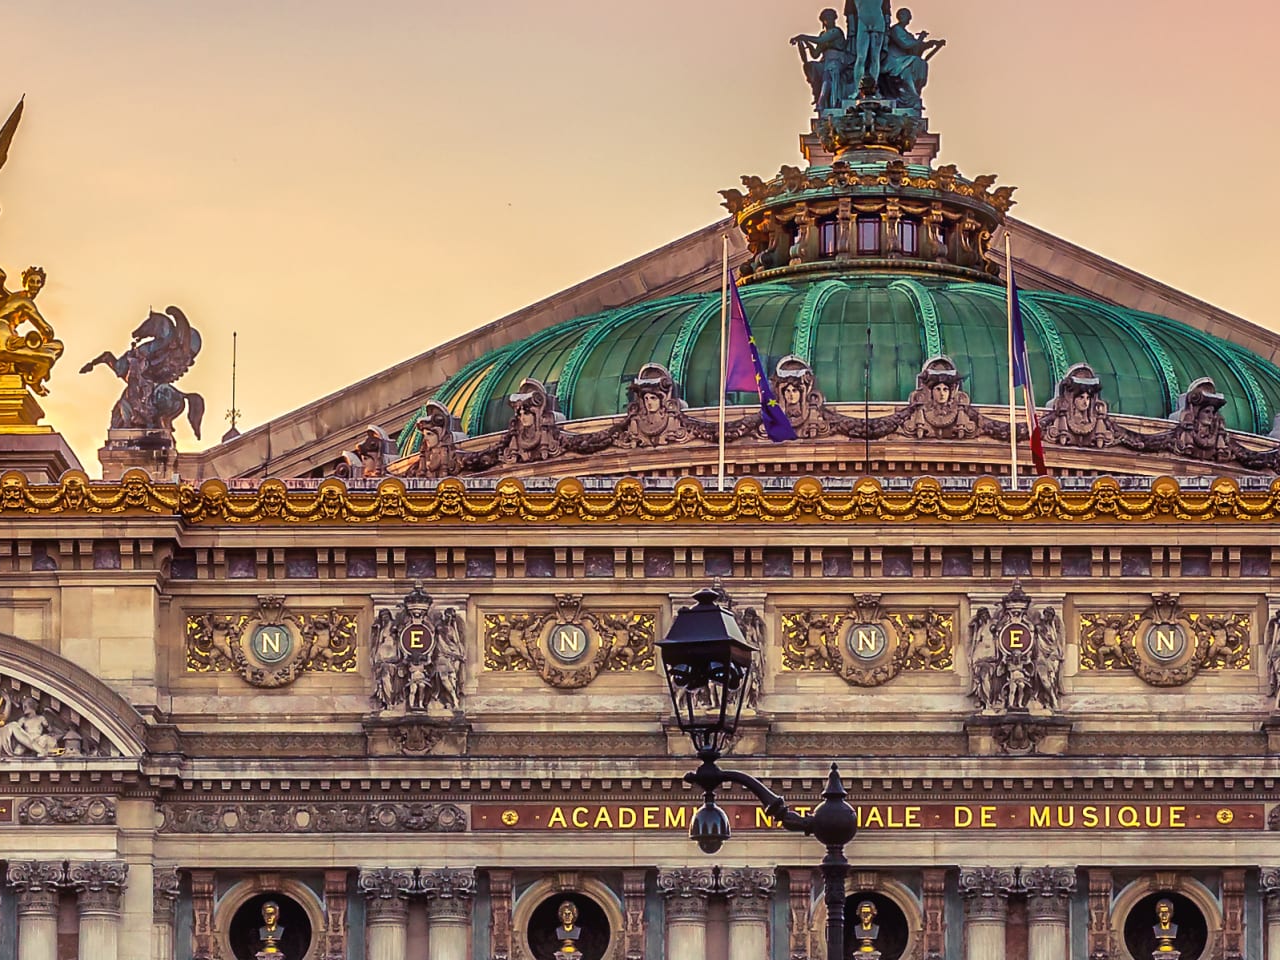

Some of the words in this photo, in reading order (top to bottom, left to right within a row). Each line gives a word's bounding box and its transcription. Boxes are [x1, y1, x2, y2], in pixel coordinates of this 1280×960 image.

[262, 632, 280, 653] N
[409, 630, 424, 648] E
[560, 631, 579, 652] N
[858, 630, 876, 651] N
[1009, 630, 1024, 648] E
[1156, 630, 1175, 651] N
[547, 806, 698, 828] ACADEM
[954, 806, 997, 828] DE
[1029, 805, 1186, 828] MUSIQUE
